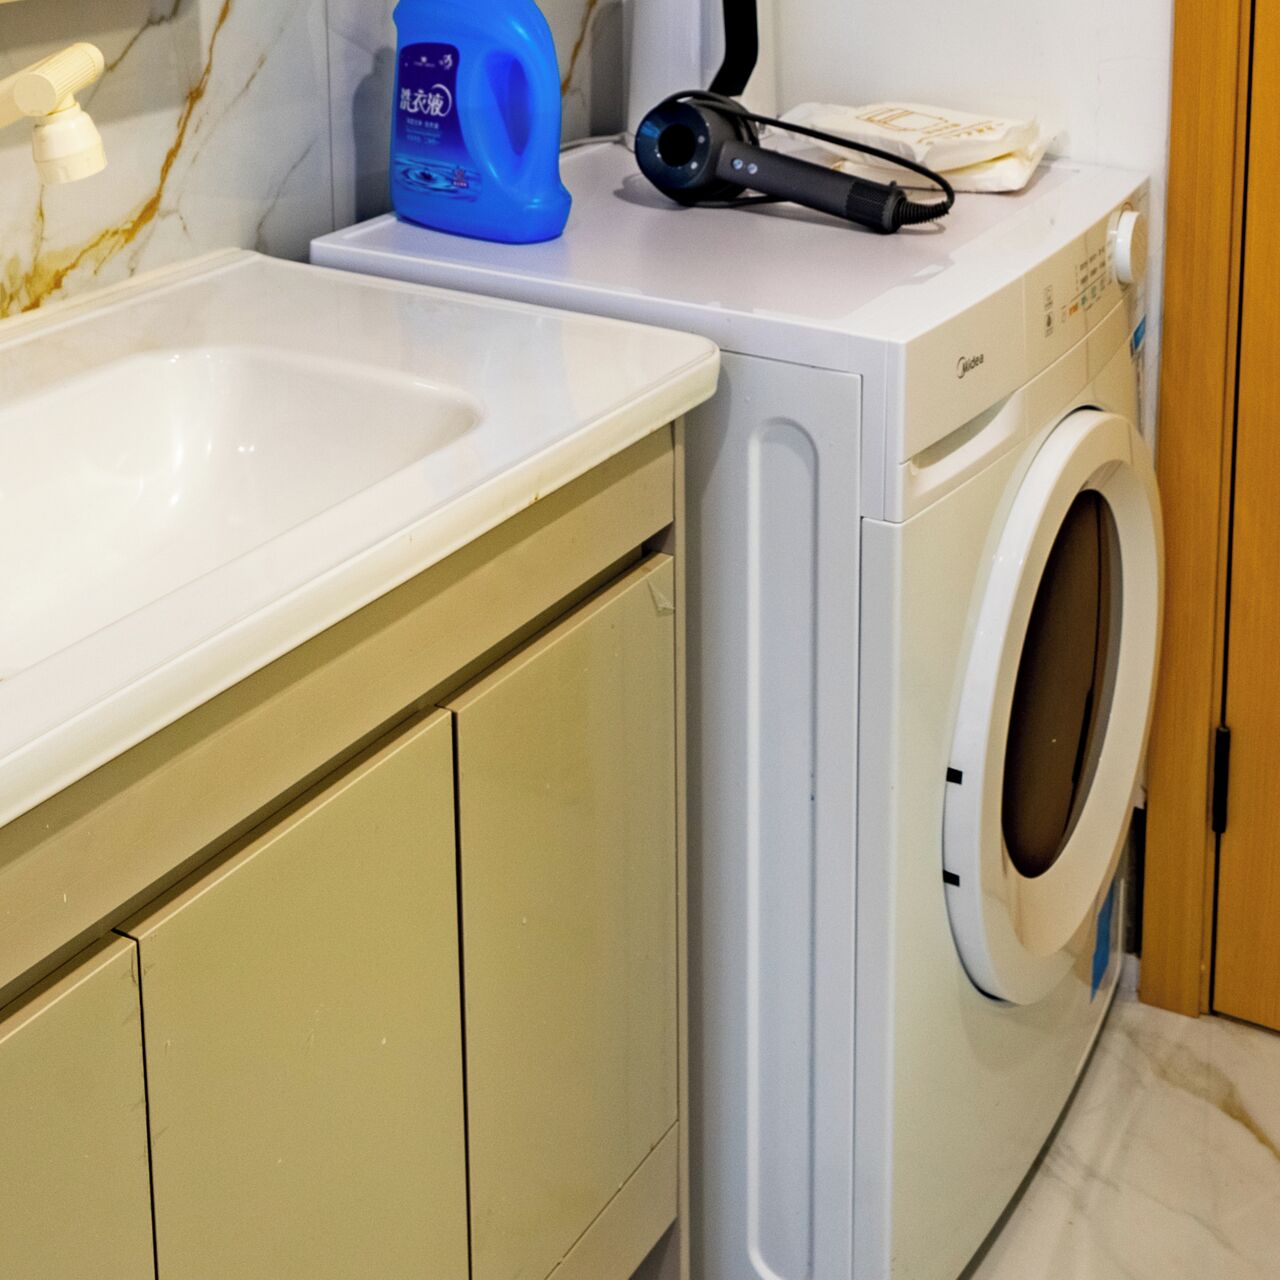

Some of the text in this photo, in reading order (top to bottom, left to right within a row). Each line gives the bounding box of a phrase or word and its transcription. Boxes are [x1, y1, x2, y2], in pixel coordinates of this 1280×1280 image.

[400, 84, 452, 116] 洗衣液
[957, 353, 984, 379] Midea
